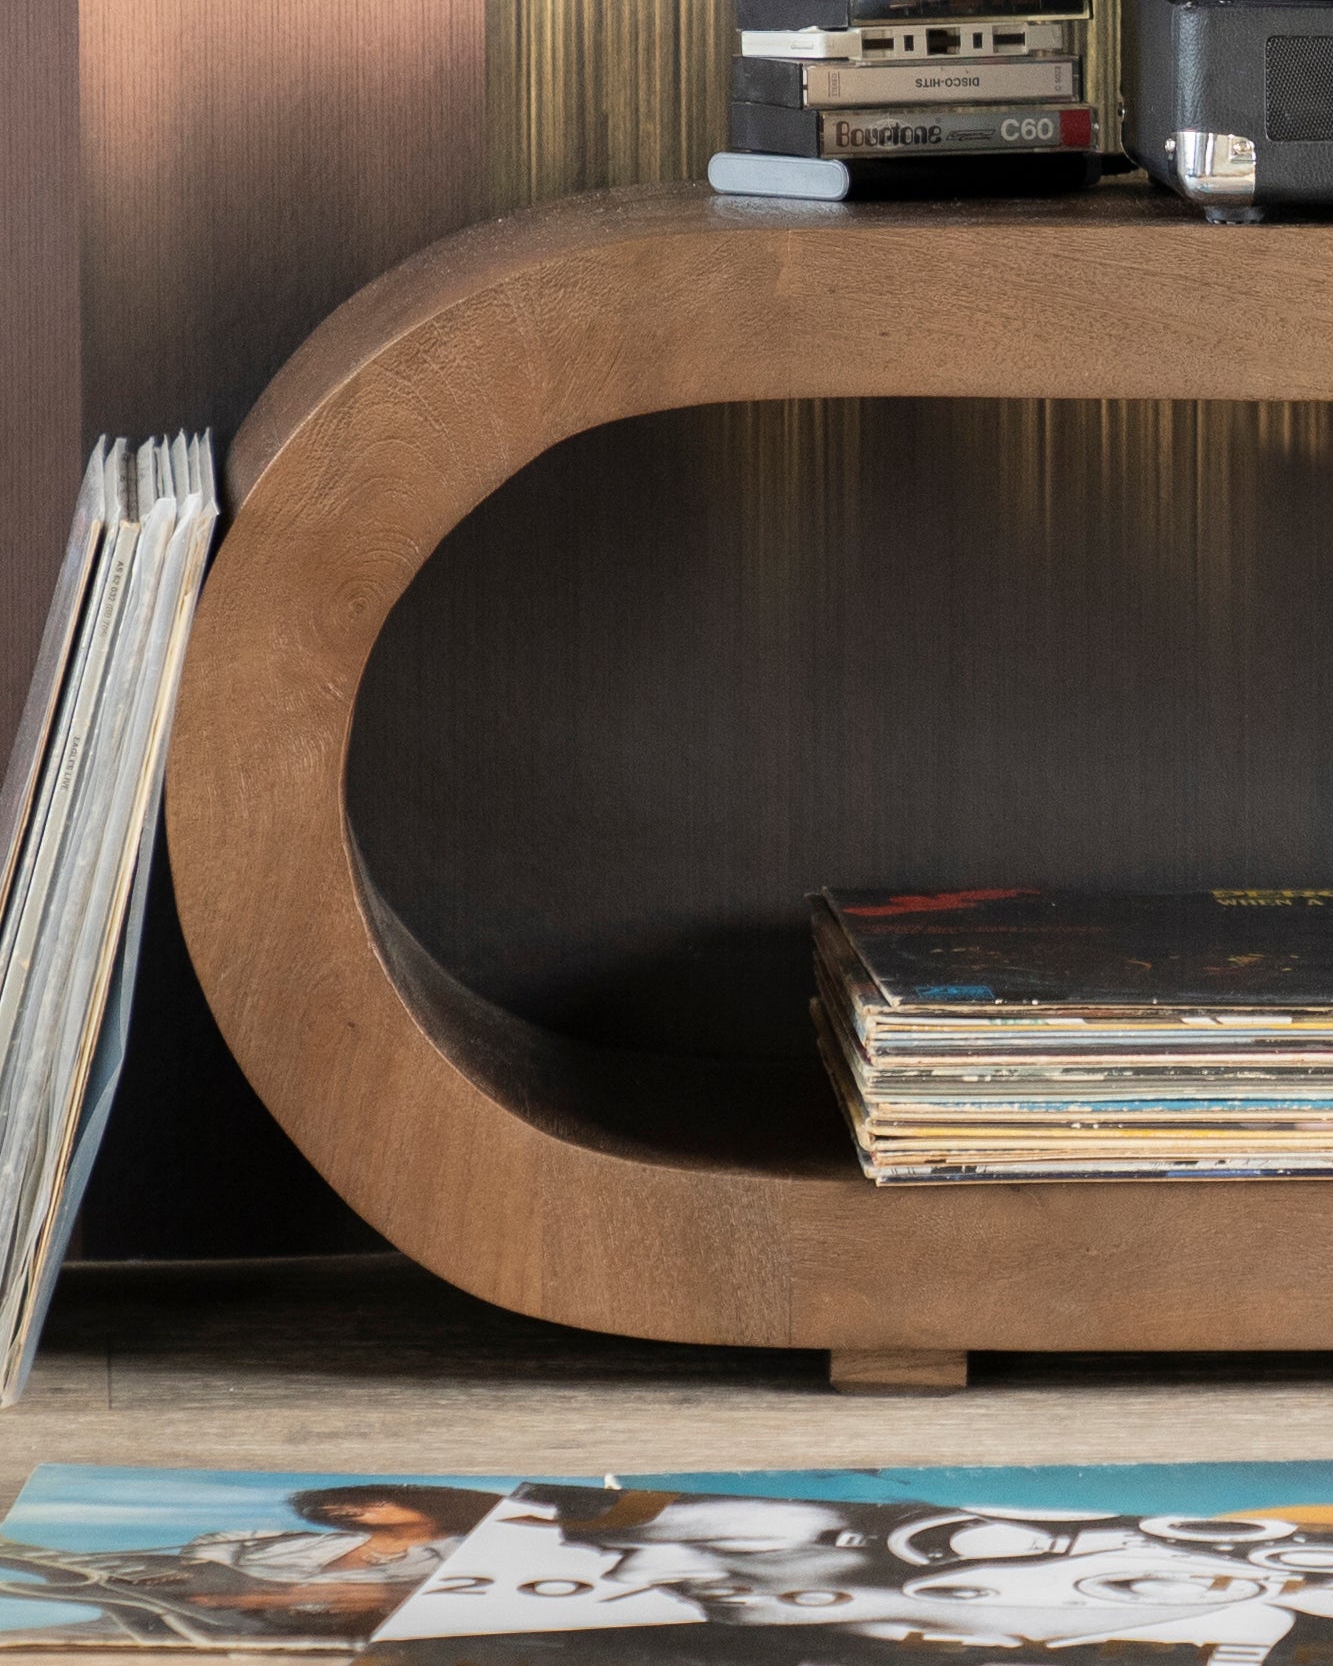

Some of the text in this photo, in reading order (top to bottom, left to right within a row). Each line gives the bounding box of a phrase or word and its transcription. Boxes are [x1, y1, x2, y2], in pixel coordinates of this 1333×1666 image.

[1000, 118, 1054, 142] C60
[61, 736, 80, 790] EAGLES LIVE
[423, 1574, 857, 1609] 20/20
